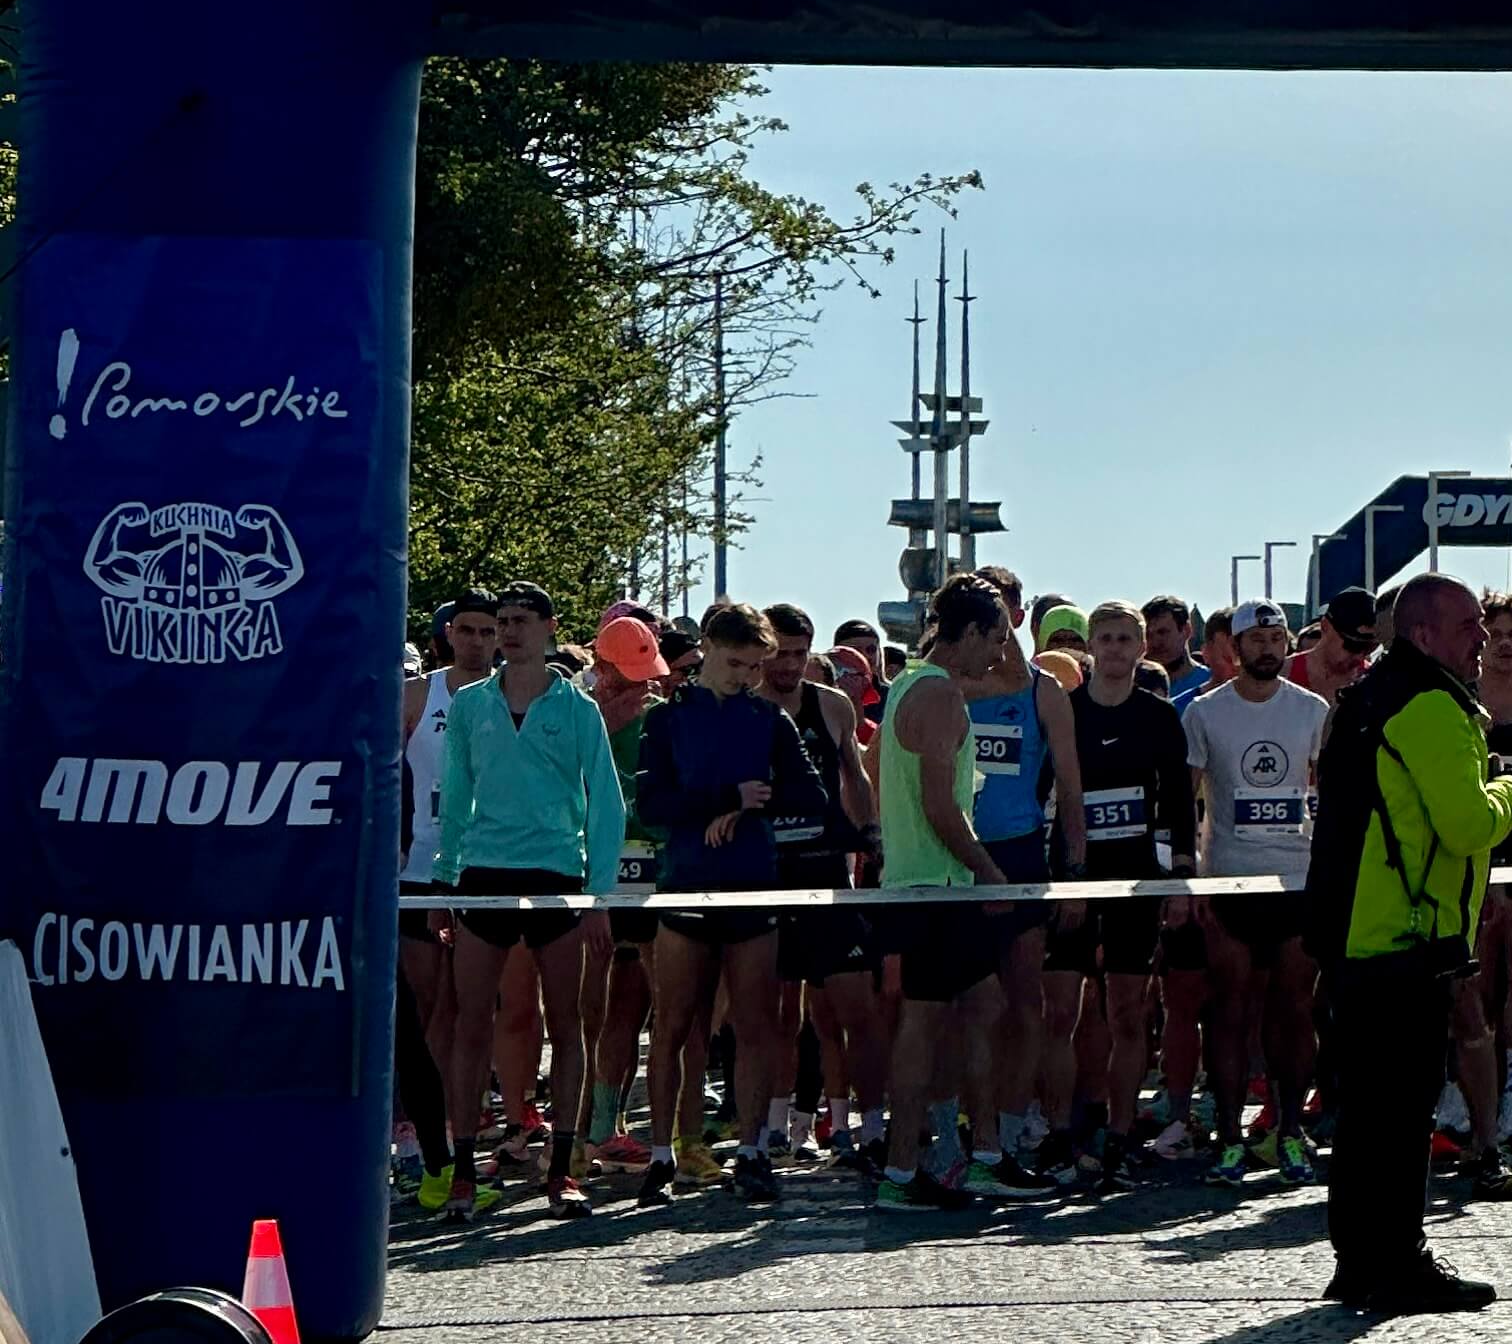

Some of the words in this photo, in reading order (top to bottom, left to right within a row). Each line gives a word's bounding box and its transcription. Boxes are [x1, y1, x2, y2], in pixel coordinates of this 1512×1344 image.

[151, 504, 235, 537] KUCHNIA
[101, 597, 283, 663] VIKINGA
[40, 757, 342, 825] 4MOVE
[1092, 804, 1131, 825] 351
[1249, 801, 1288, 820] 396
[33, 912, 345, 991] CISOWIANKA
